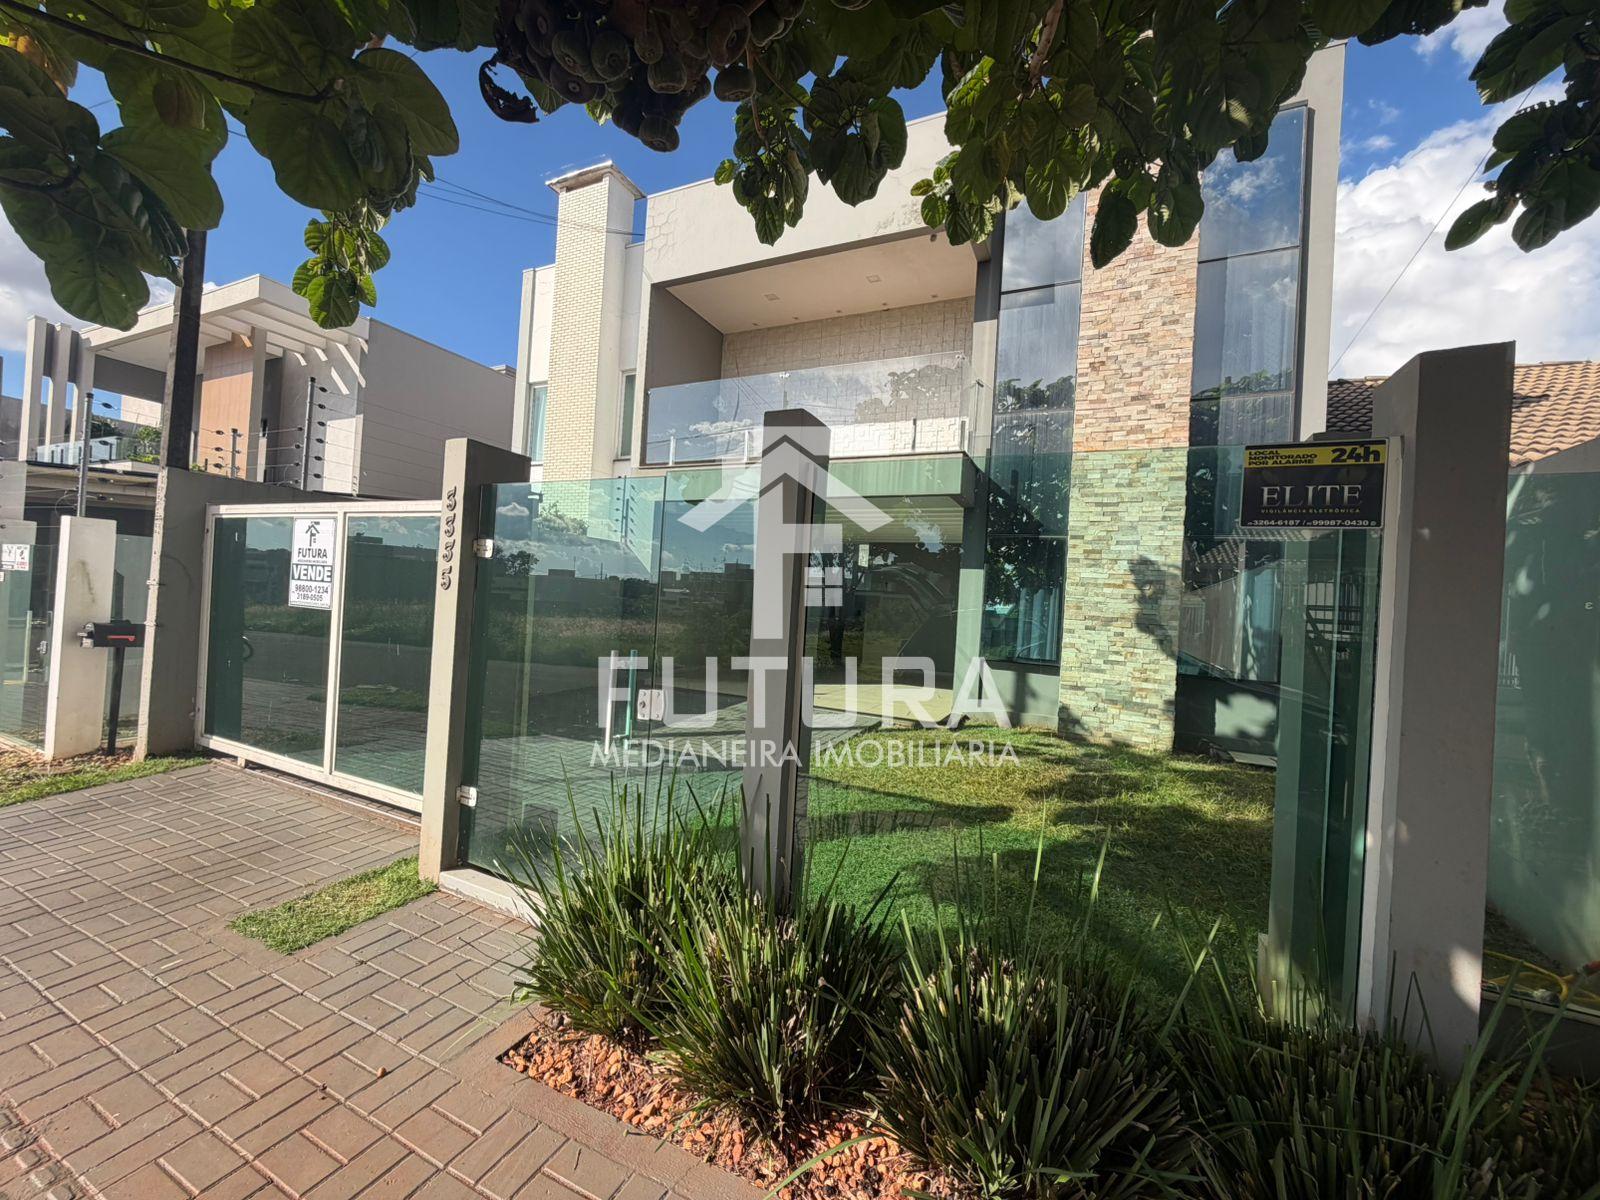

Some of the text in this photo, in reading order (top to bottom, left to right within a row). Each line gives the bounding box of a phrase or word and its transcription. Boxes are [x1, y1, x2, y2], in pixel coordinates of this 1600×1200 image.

[1248, 453, 1318, 461] MONITORADO
[1331, 446, 1381, 463] 24h
[1261, 484, 1363, 508] ELITE
[440, 486, 457, 590] 3335
[297, 547, 328, 559] FUTURA
[292, 564, 332, 582] VENDE
